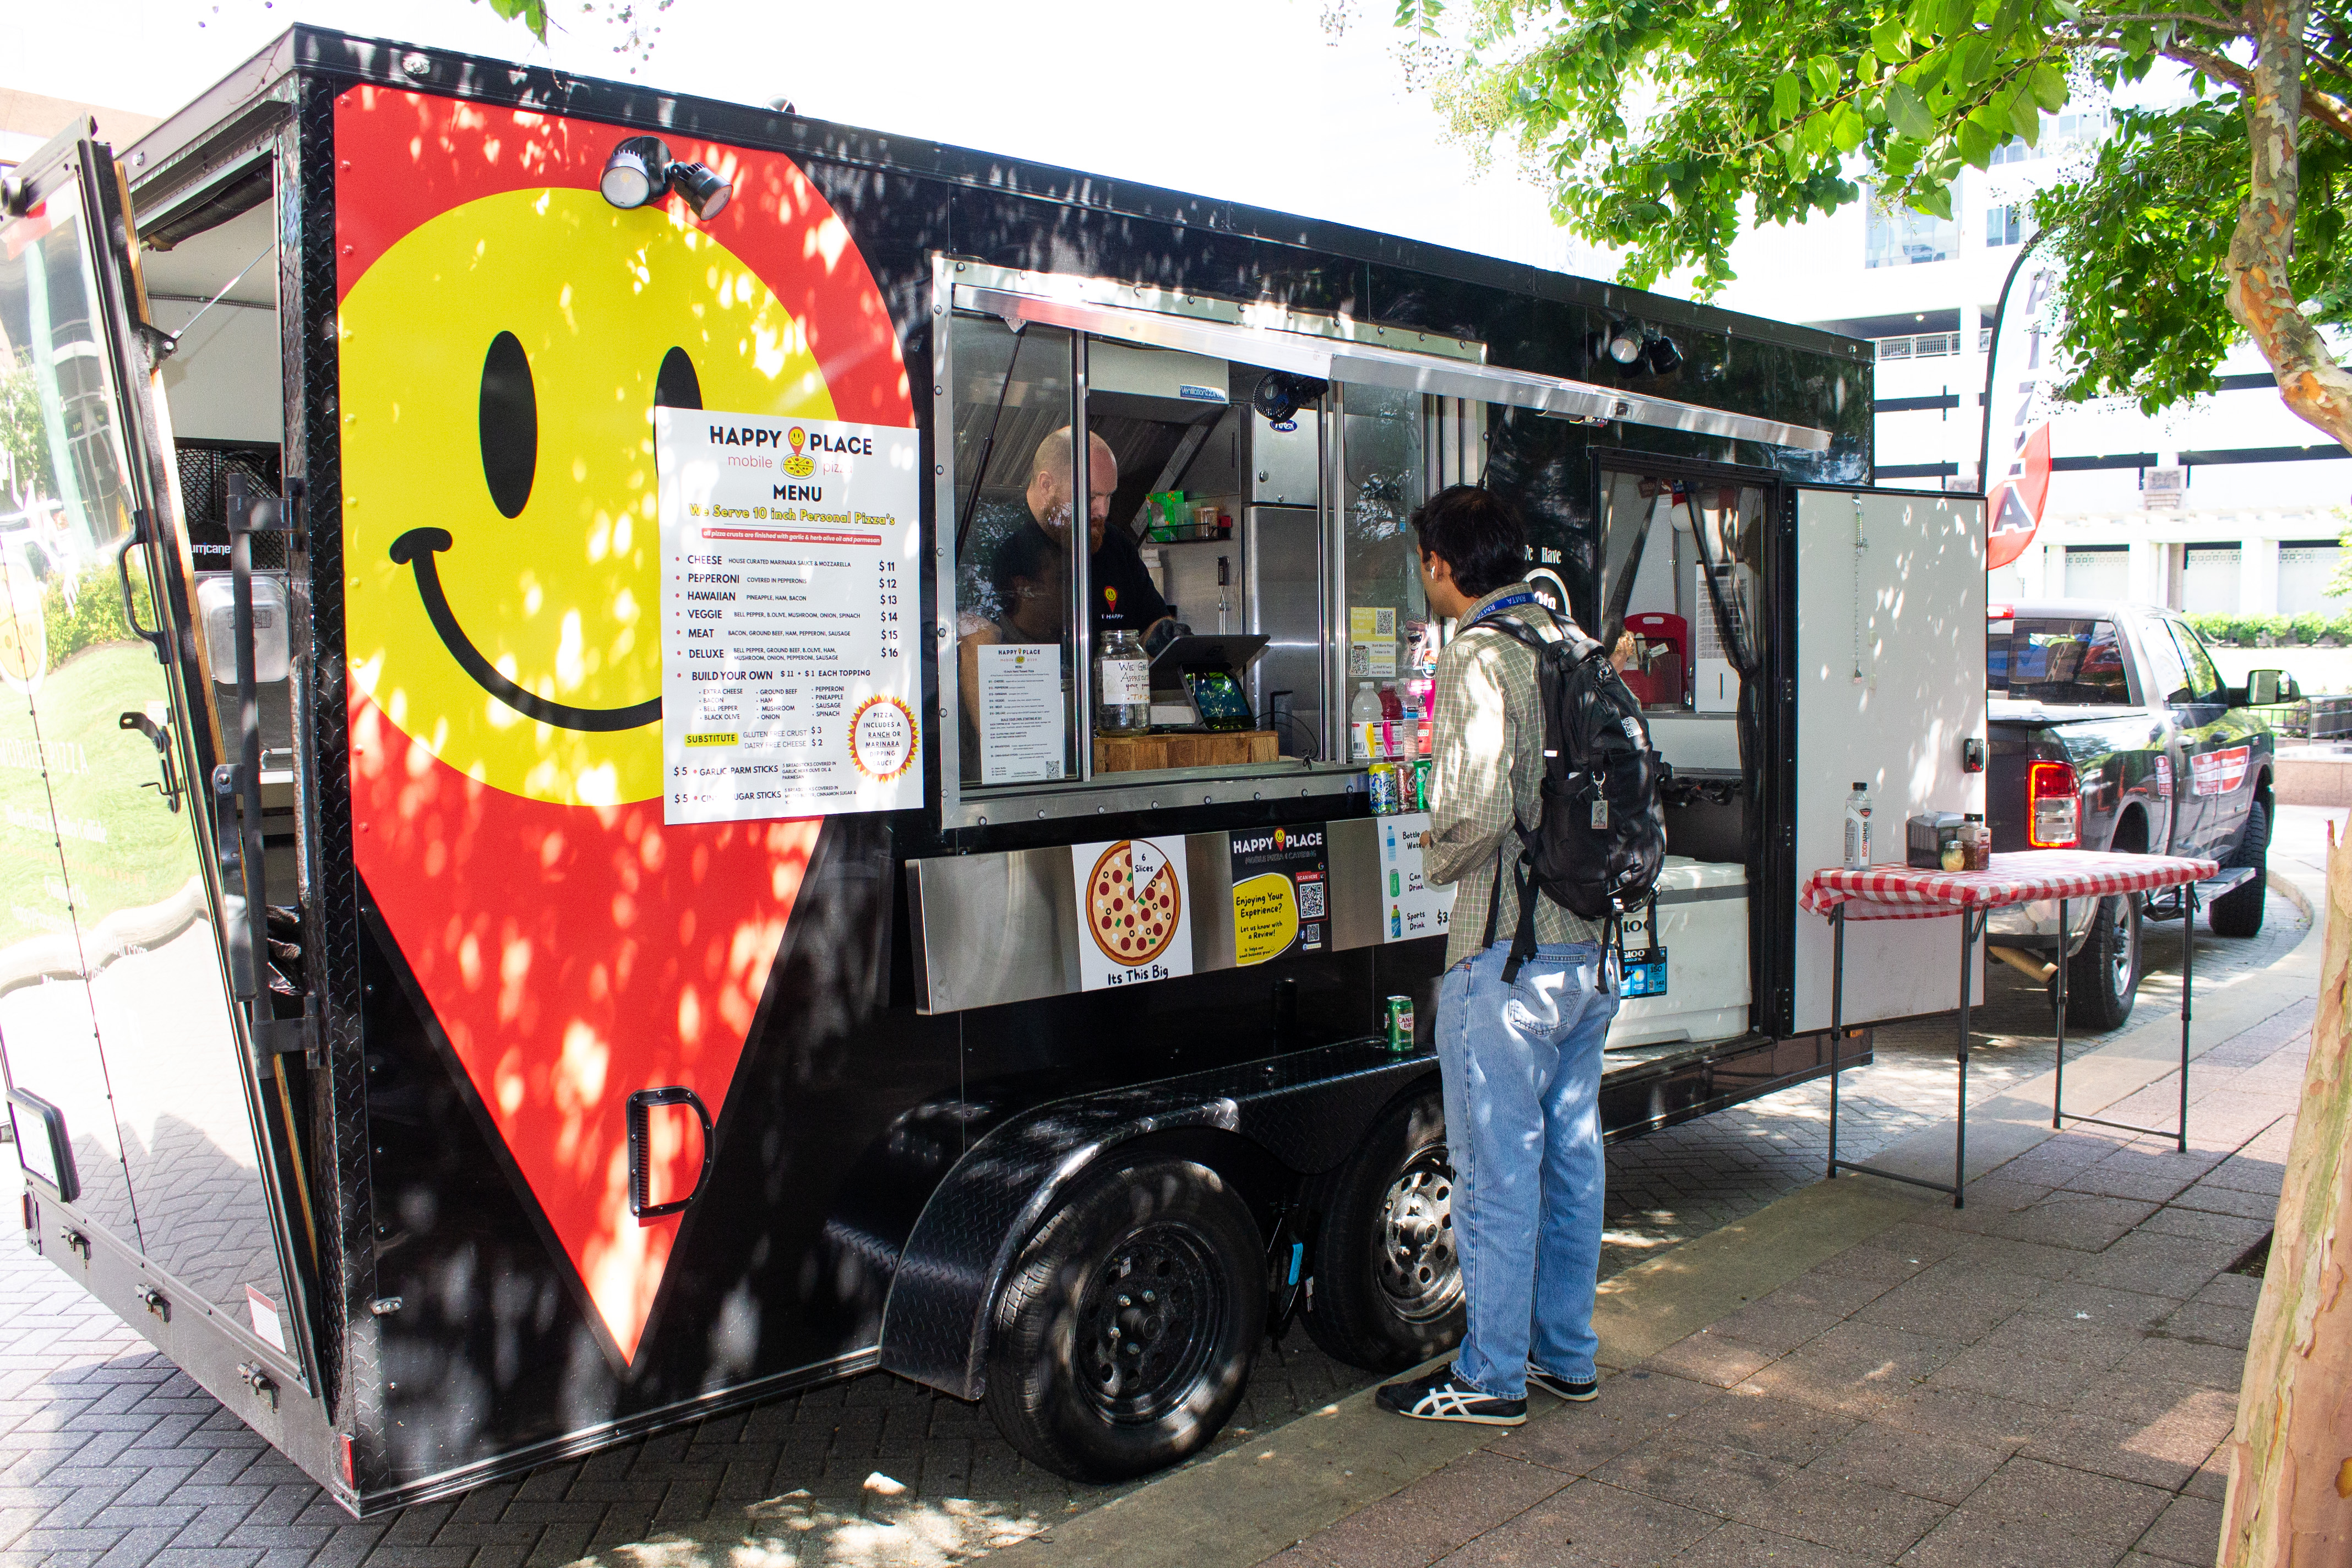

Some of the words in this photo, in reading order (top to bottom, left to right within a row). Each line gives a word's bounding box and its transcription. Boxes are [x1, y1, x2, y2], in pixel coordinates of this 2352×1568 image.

[710, 425, 781, 448] HAPPY
[810, 433, 872, 455] PLACE
[728, 454, 772, 468] mobile
[823, 460, 852, 475] pizza
[773, 484, 821, 502] MENU
[689, 504, 709, 516] We
[712, 504, 749, 518] Serve
[753, 506, 767, 519] 10
[771, 507, 796, 520] inch
[799, 509, 851, 523] Personal
[854, 511, 895, 525] Pizza's
[190, 543, 231, 556] urricane
[687, 554, 722, 564] CHEESE
[1542, 547, 1561, 564] Have
[688, 573, 739, 583] PEPPERONI
[688, 591, 736, 600] HAWAIIAN
[687, 609, 722, 618] VEGGIE
[688, 629, 714, 638] MEAT
[689, 649, 723, 658] DELUXE
[1119, 662, 1134, 671] WE
[692, 671, 718, 680] BUILD
[720, 671, 746, 680] YOUR
[749, 671, 772, 679] OWN
[687, 734, 736, 743] SUBSTITUTE
[47, 741, 90, 775] PIZZA
[753, 765, 778, 774] STICKS
[756, 791, 781, 799] STICKS
[1402, 831, 1420, 840] Bottle
[1233, 837, 1273, 853] HAPPY
[1286, 832, 1322, 847] PLACE
[1407, 842, 1423, 850] Wate
[1245, 855, 1266, 864] MOBILE
[1267, 853, 1283, 862] PIZZA
[1288, 850, 1316, 859] CATERING
[1135, 864, 1153, 873] Slices
[1409, 873, 1421, 881] Can
[1409, 883, 1424, 891] Drink
[1236, 895, 1266, 907] Enjoying
[1267, 892, 1283, 901] Your
[1241, 903, 1282, 919] Experience?
[1407, 911, 1425, 922] Sports
[1409, 922, 1425, 930] Drink
[1108, 972, 1122, 986] Its
[1126, 969, 1149, 983] This
[1152, 965, 1168, 980] Big
